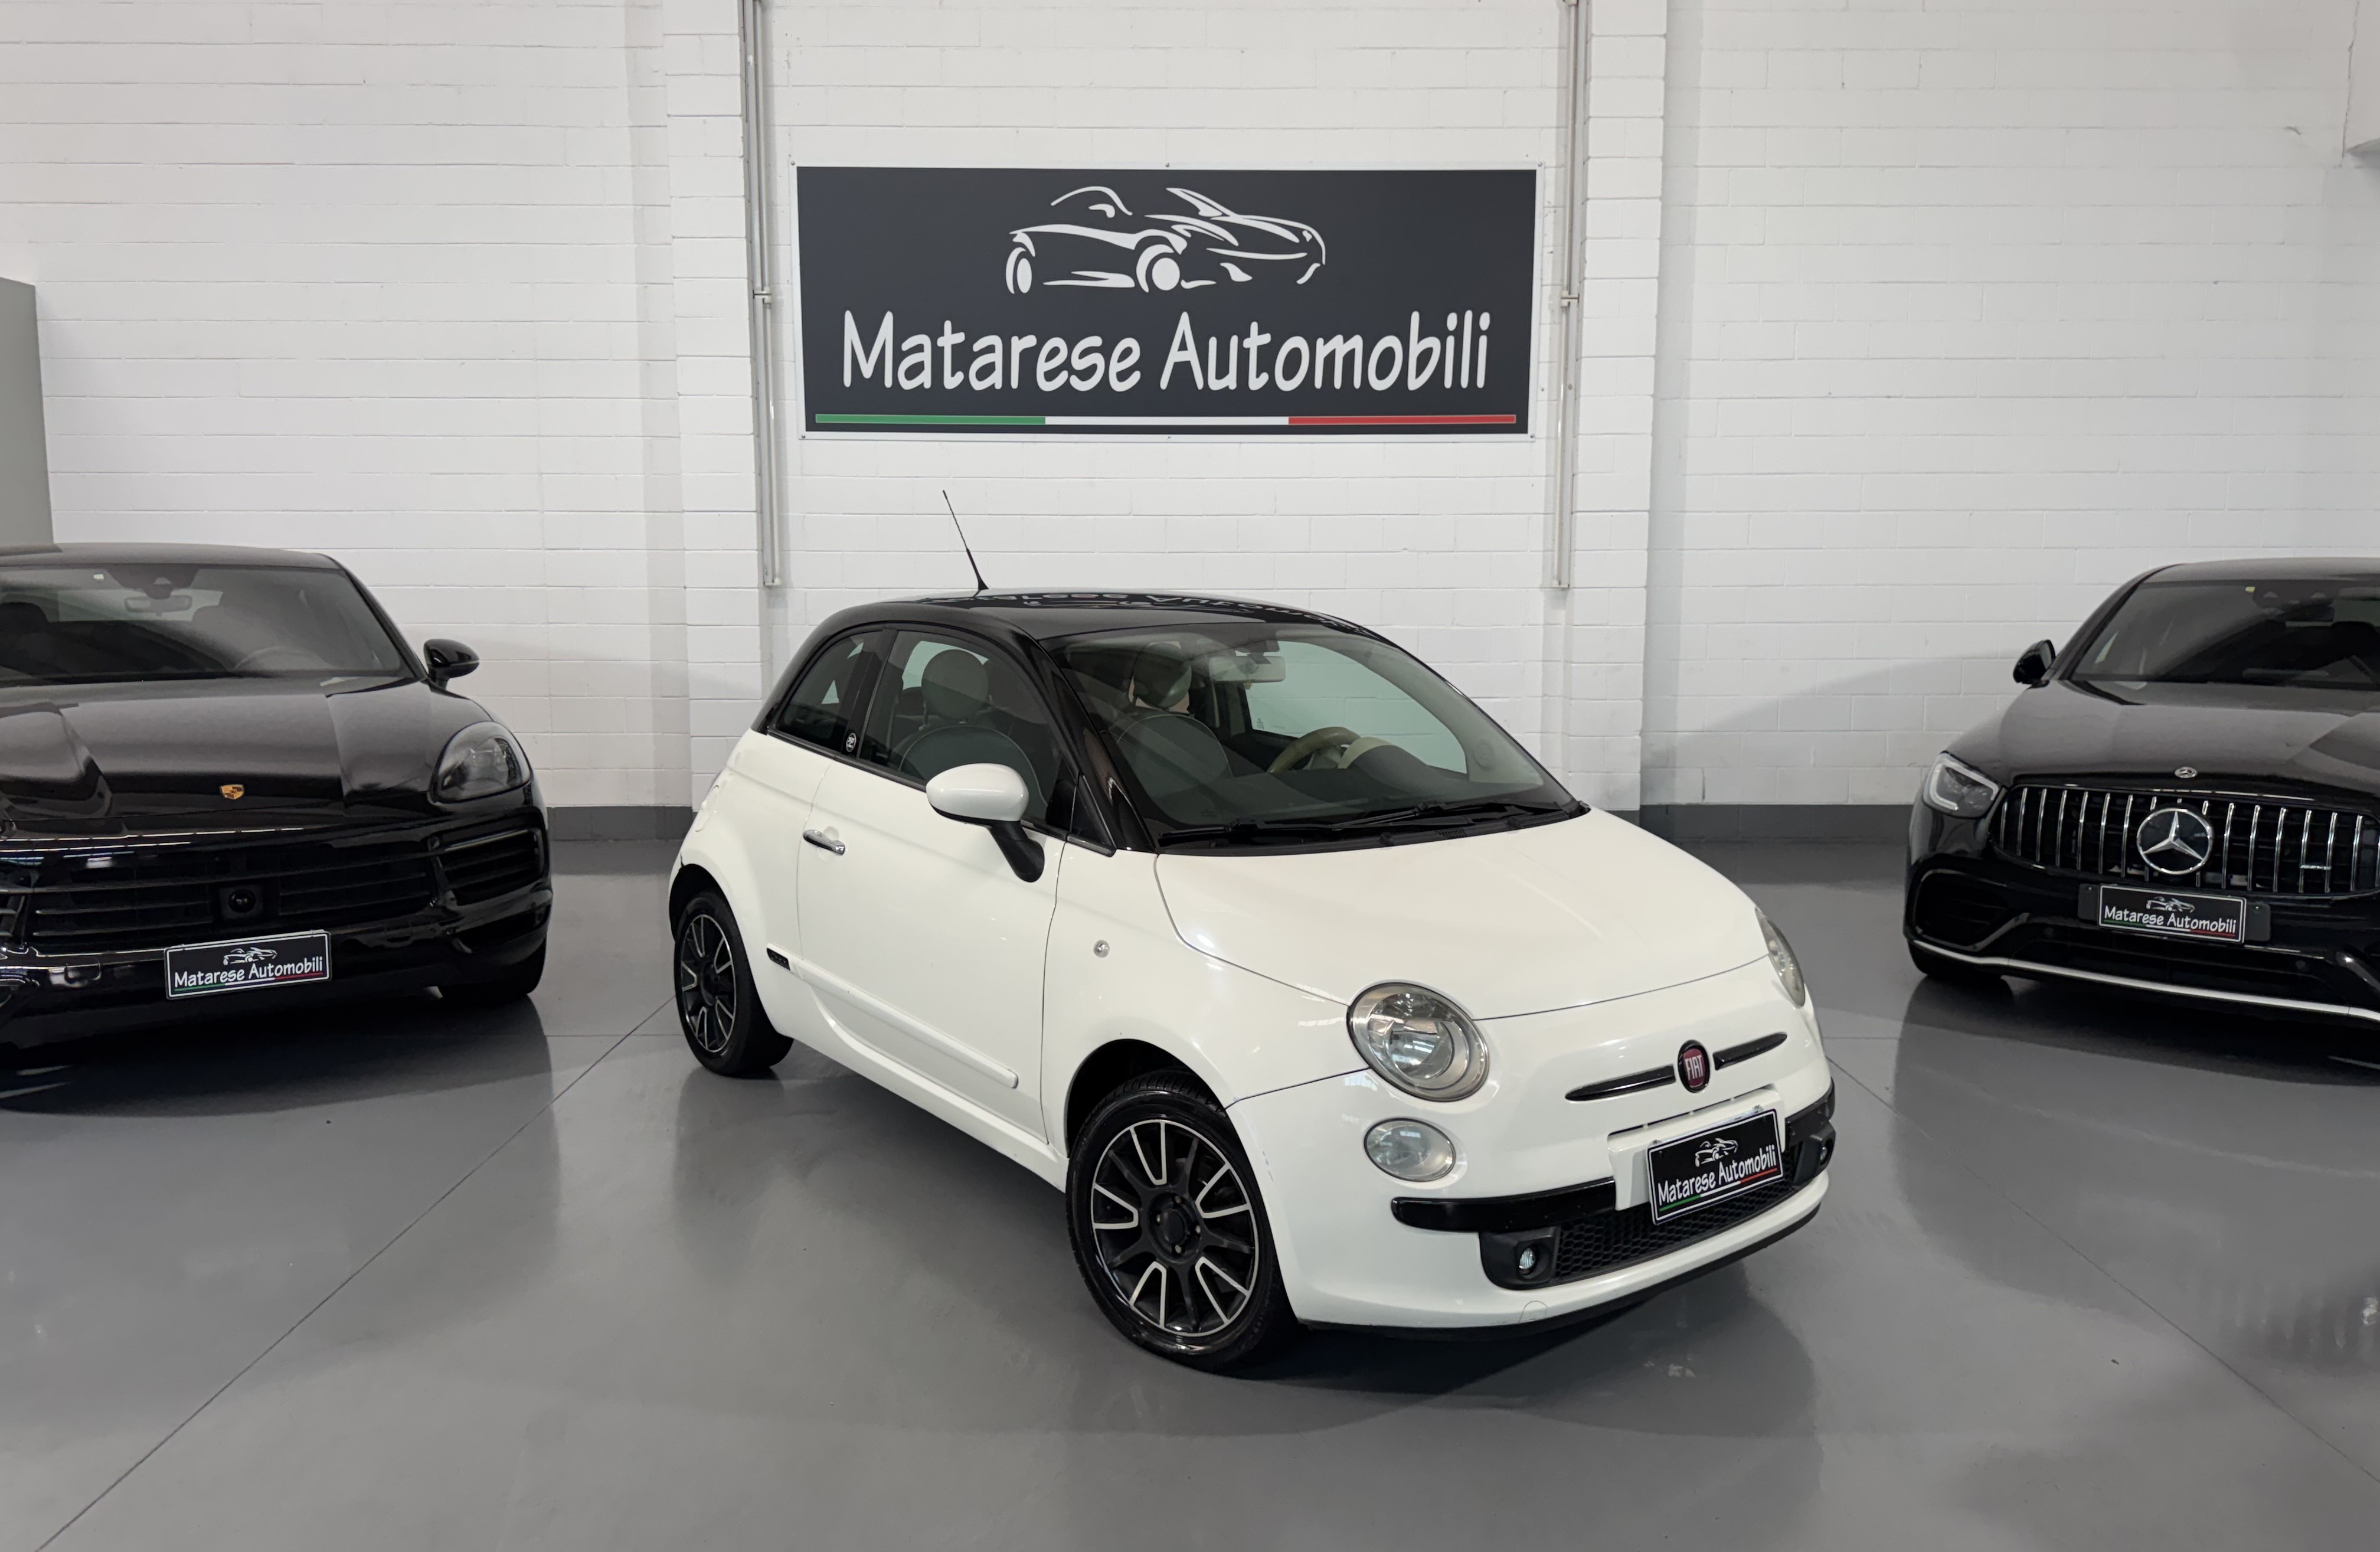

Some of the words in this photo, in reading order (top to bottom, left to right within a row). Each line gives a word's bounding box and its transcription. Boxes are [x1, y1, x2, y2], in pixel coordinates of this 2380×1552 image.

[842, 310, 1142, 393] Matarese
[1159, 309, 1491, 393] Automobili
[2104, 905, 2164, 926] Matarese
[2167, 913, 2237, 934] Automobili
[174, 968, 244, 988] Matarese
[249, 956, 323, 979] Automobili
[1685, 1054, 1703, 1080] FIAT
[1658, 1172, 1715, 1206] Matarese
[1718, 1144, 1777, 1185] Automobili
